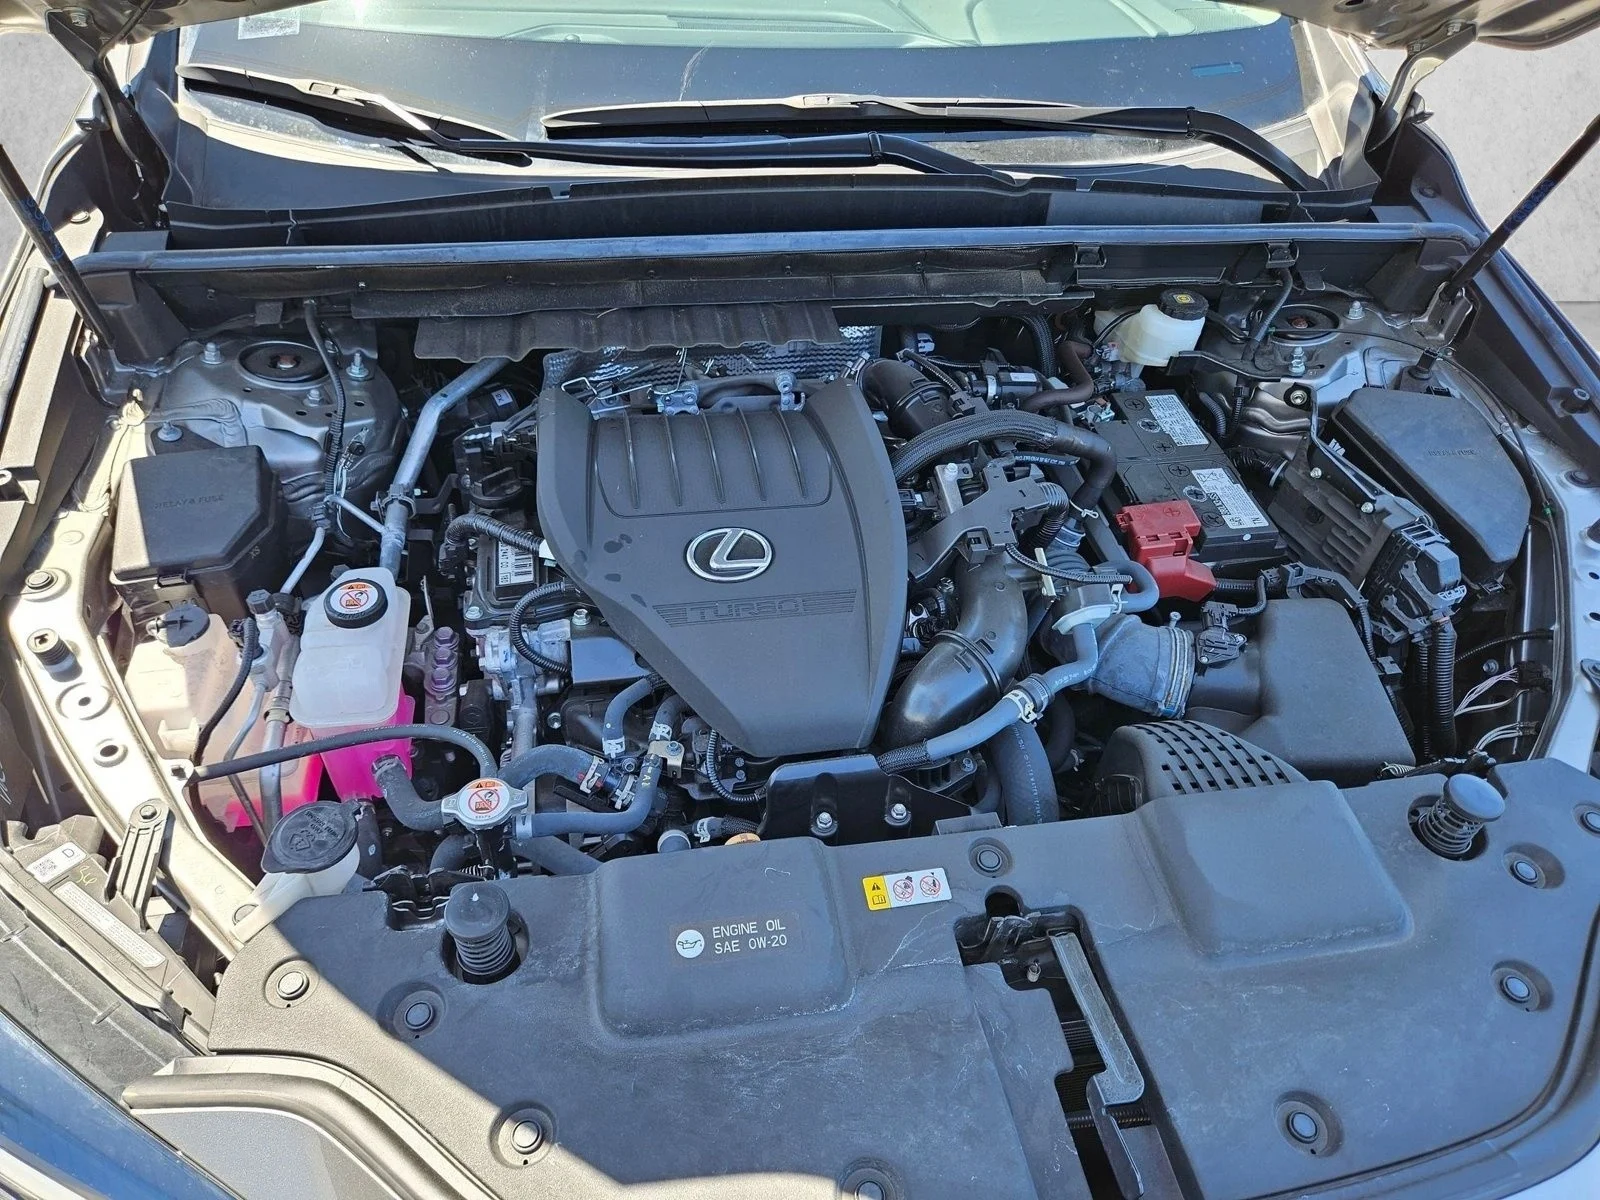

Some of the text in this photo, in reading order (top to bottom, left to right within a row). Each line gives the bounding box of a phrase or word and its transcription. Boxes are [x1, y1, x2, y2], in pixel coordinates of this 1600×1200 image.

[690, 599, 800, 620] TURBO
[712, 919, 786, 939] ENGINE OIL
[714, 934, 788, 955] SAE 0W-20
